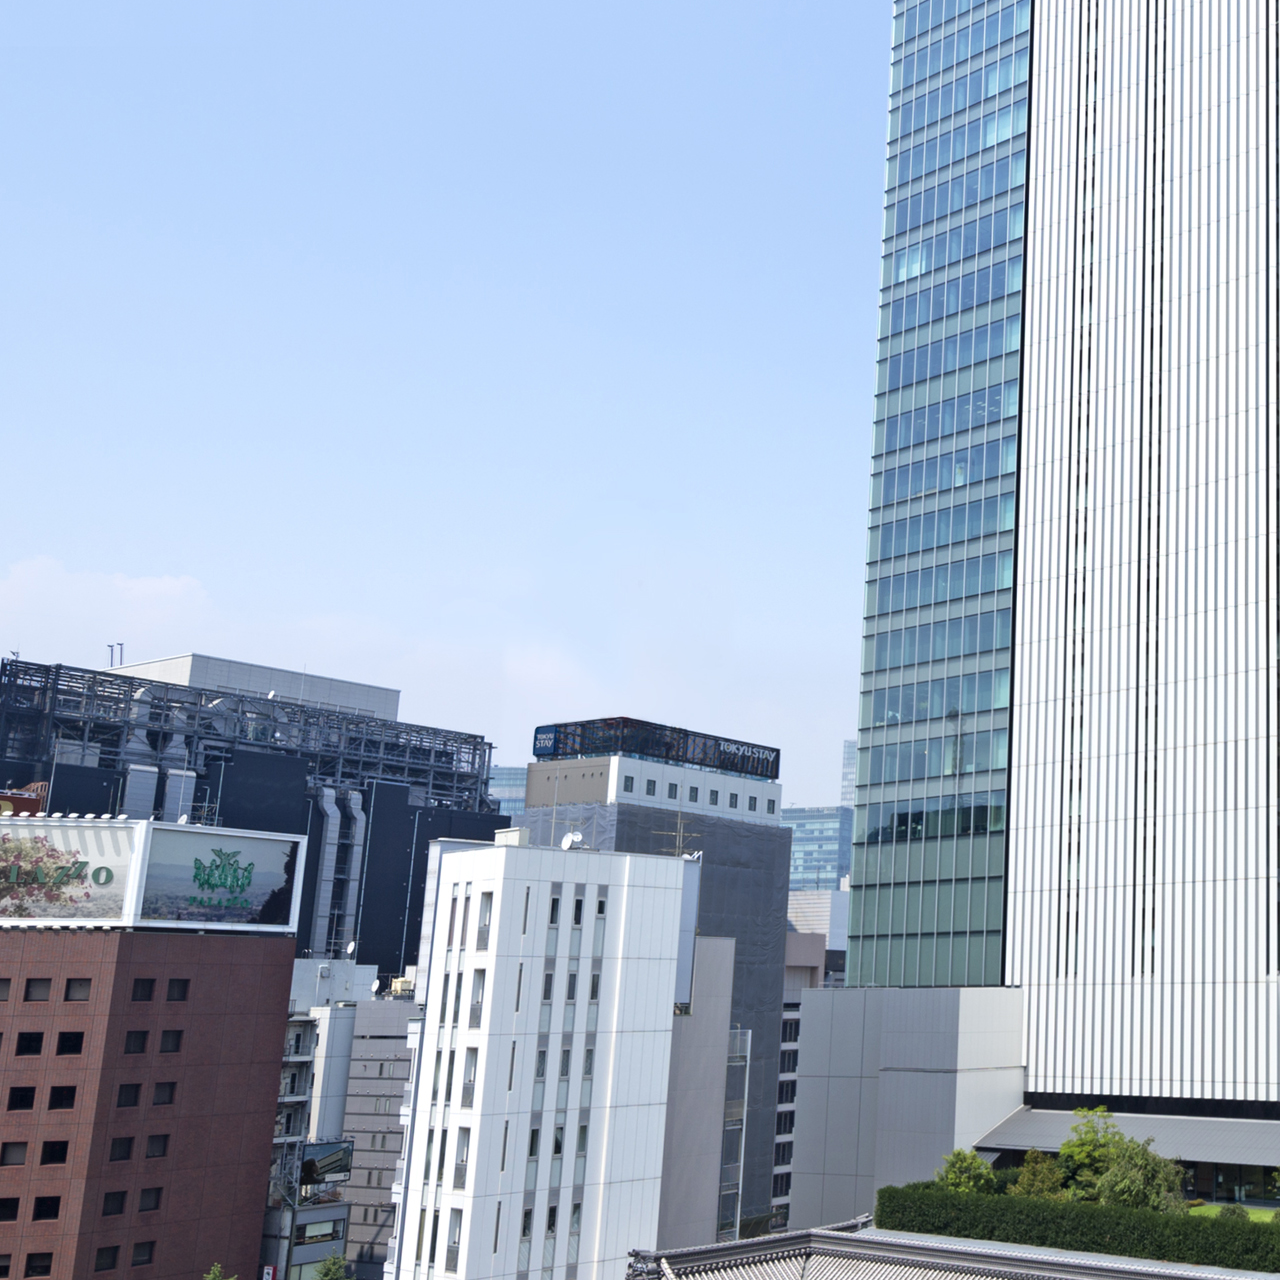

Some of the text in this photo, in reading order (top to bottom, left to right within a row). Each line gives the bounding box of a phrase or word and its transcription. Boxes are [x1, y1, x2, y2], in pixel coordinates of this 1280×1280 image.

[536, 733, 554, 741] TOKYU
[536, 739, 554, 748] STAY
[718, 741, 777, 761] TOKYU STAY
[188, 895, 251, 909] PALAZZO
